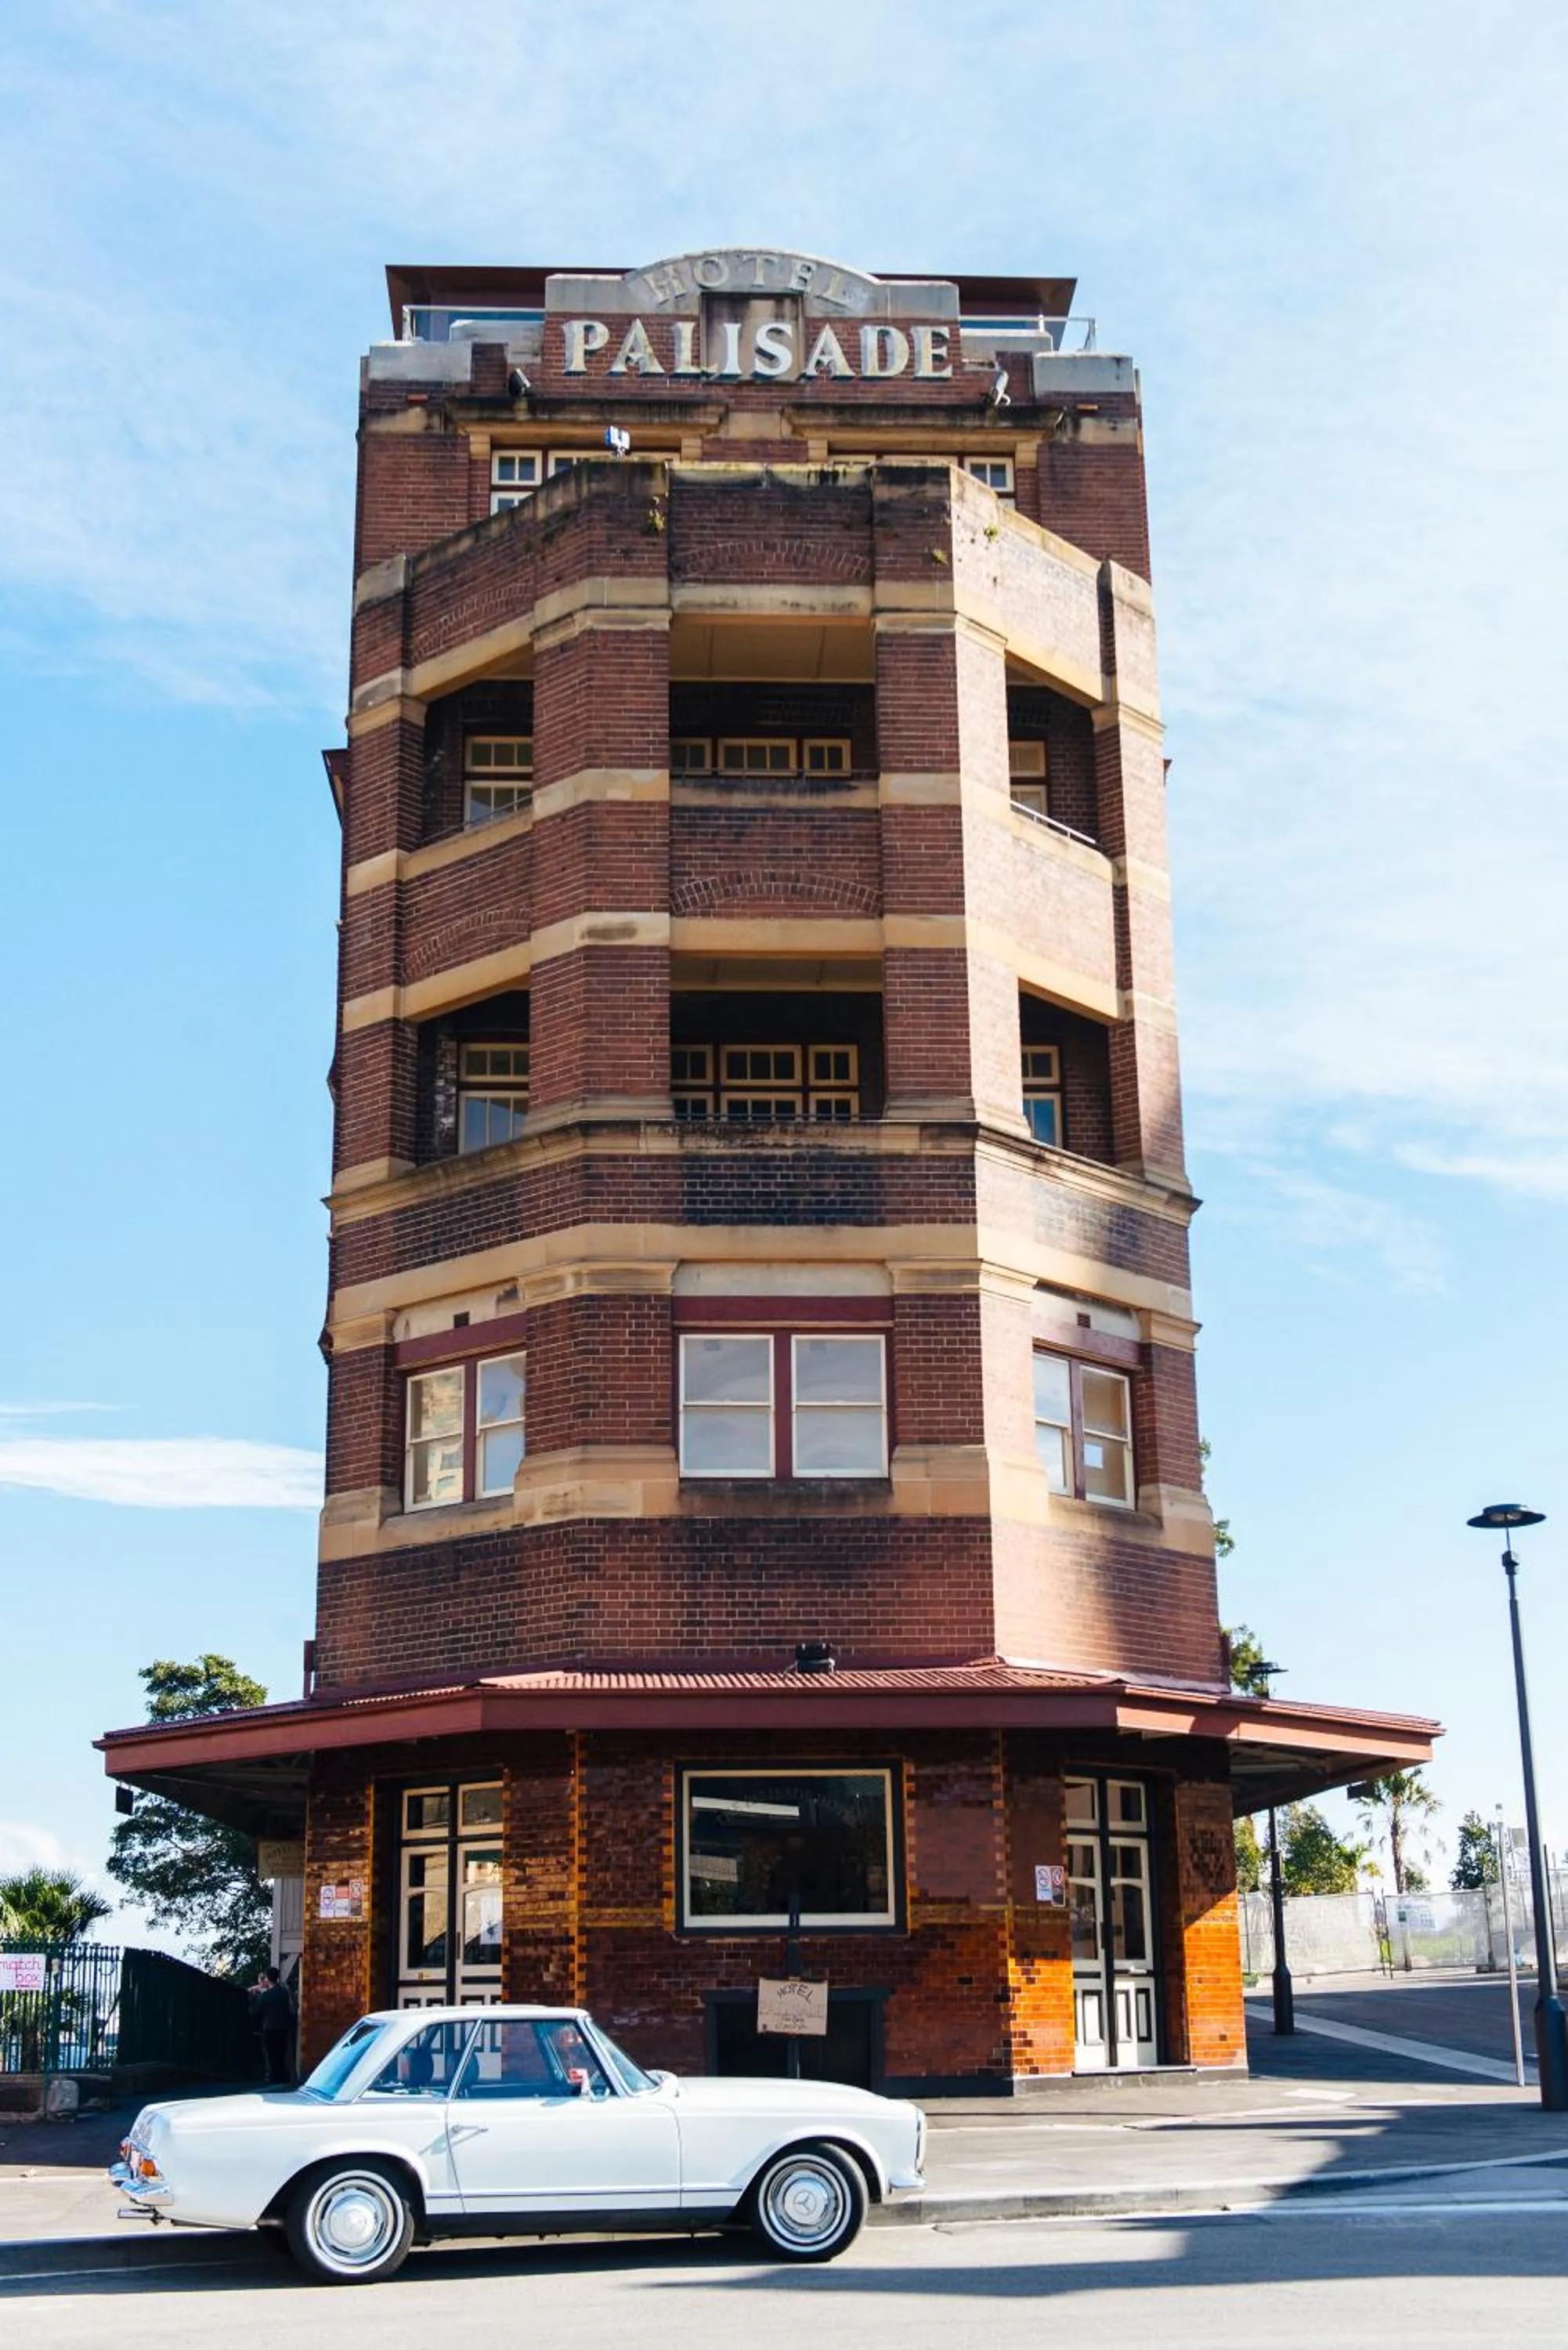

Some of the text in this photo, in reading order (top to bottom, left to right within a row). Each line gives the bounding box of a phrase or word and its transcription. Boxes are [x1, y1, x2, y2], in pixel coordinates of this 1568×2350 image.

[645, 255, 853, 305] HOTEL
[562, 317, 954, 380] PALISADE
[16, 1969, 42, 1983] box
[776, 1983, 814, 2005] HOTEL
